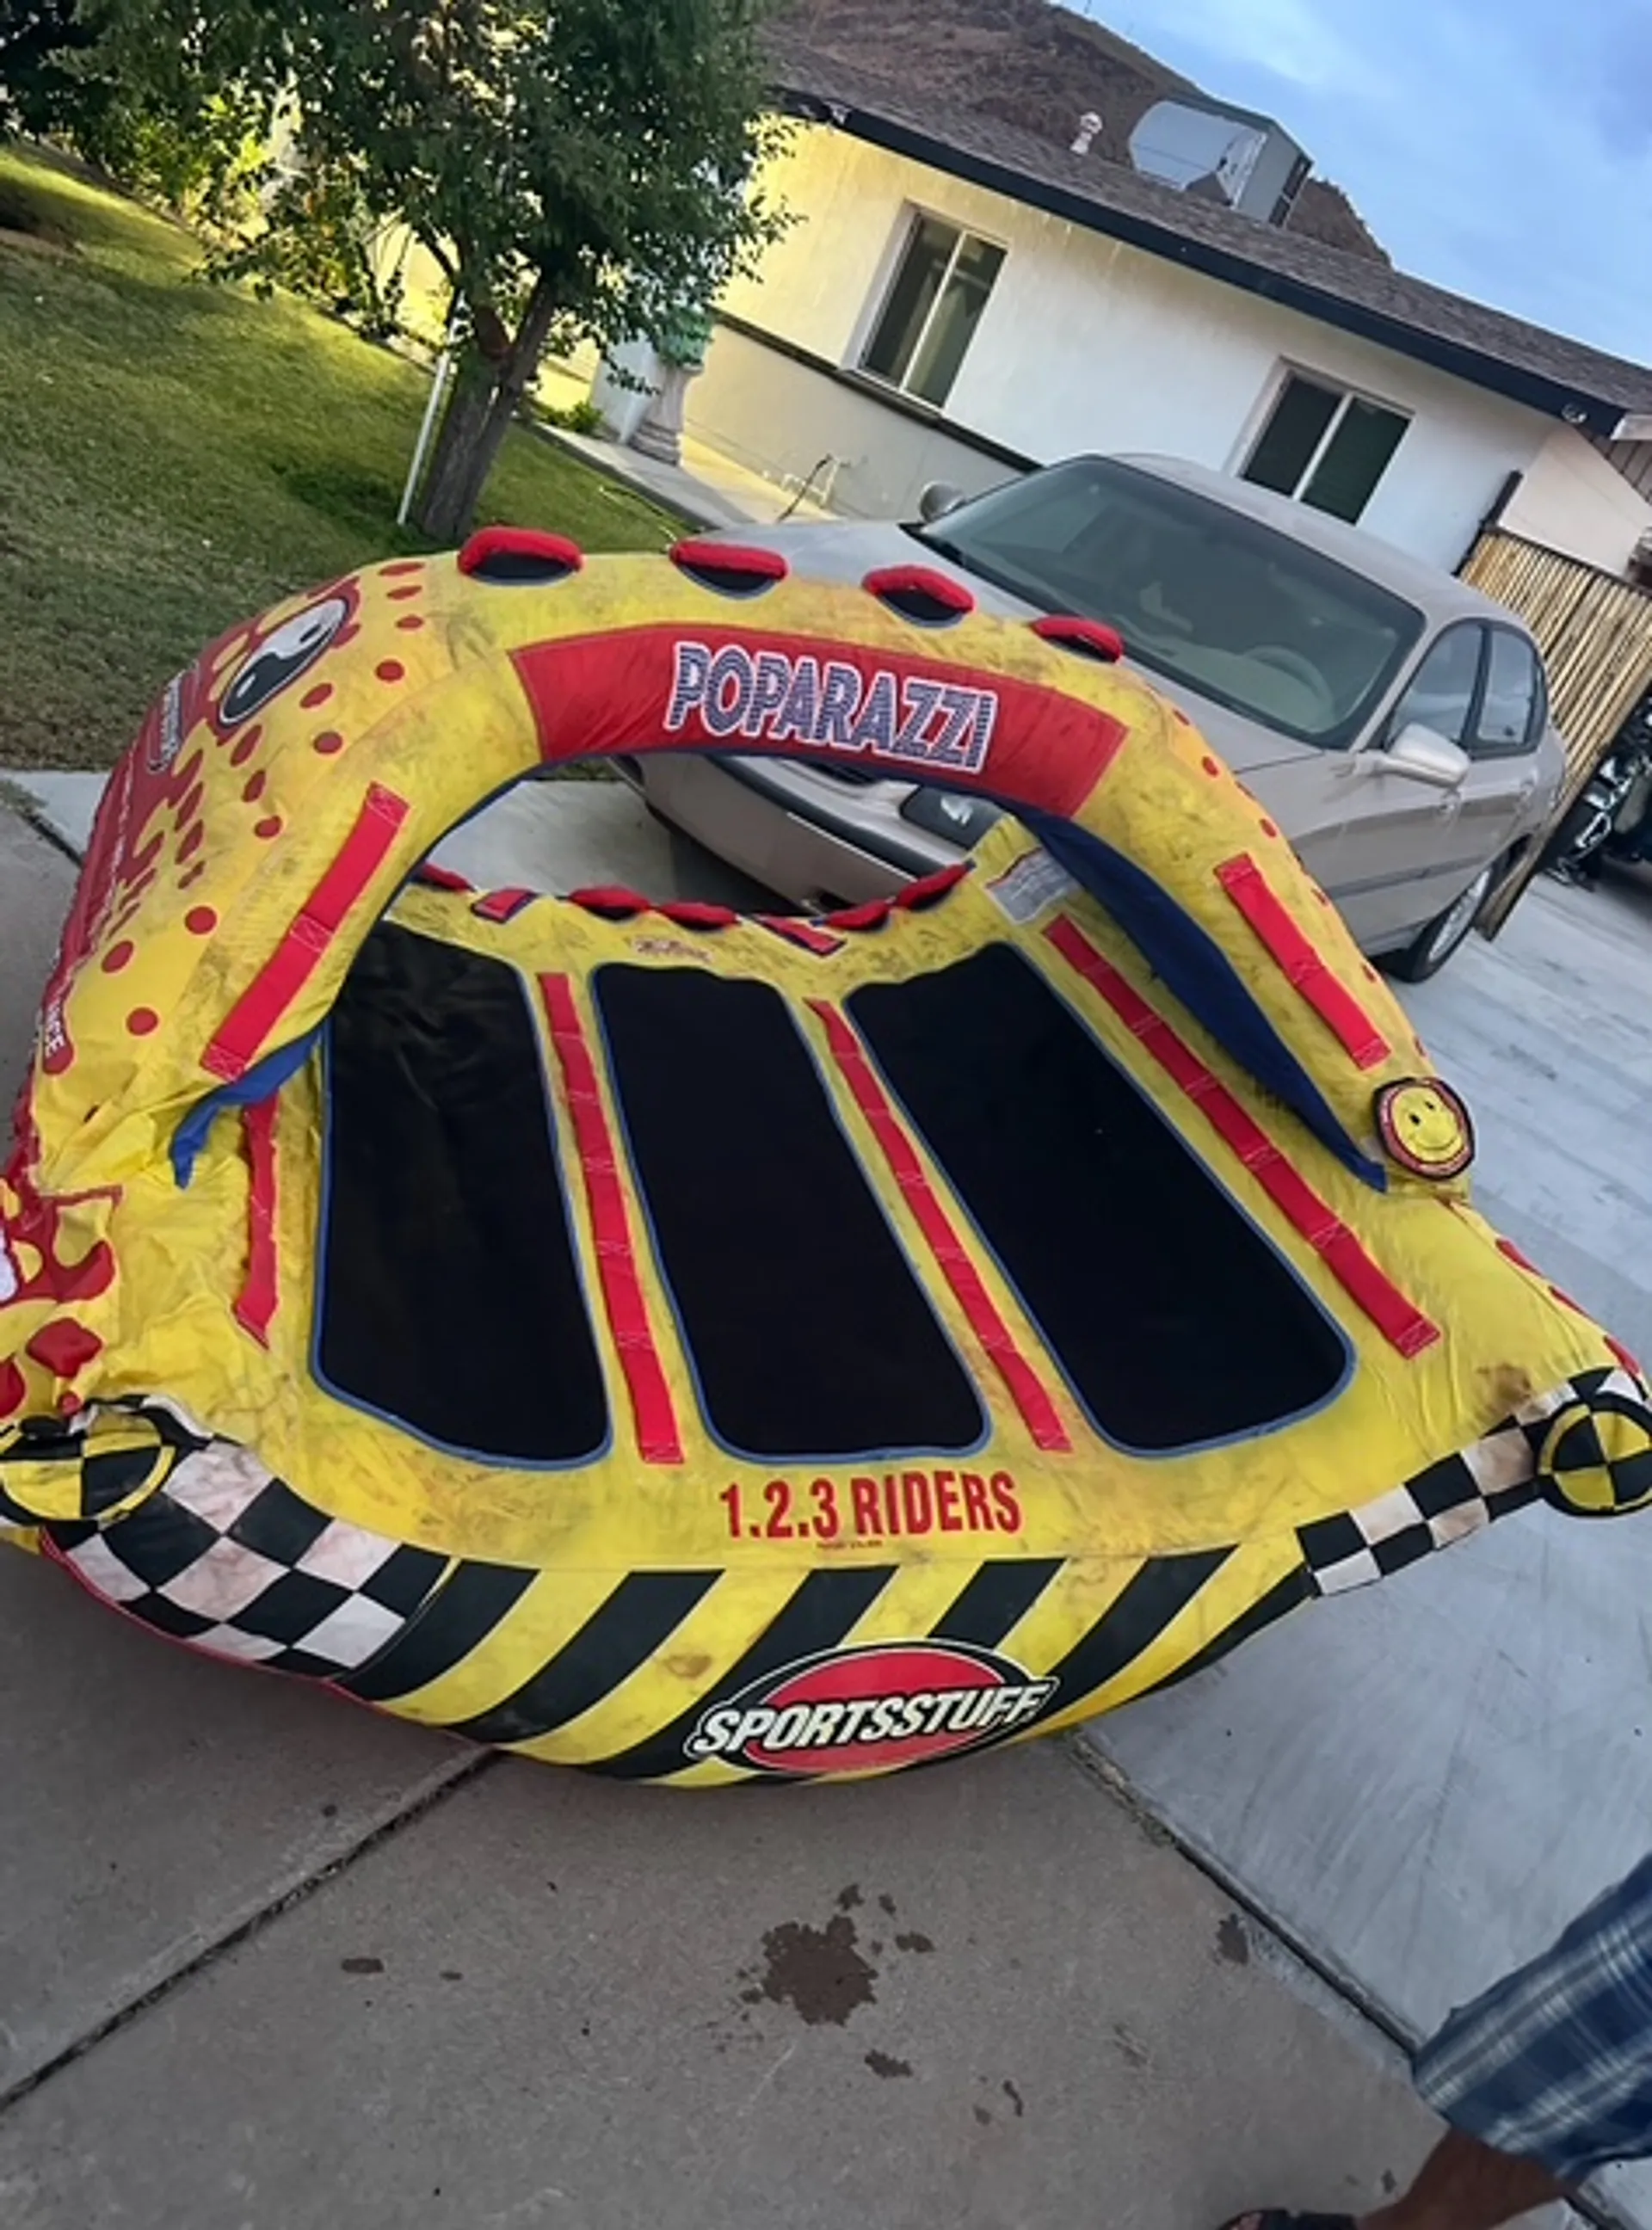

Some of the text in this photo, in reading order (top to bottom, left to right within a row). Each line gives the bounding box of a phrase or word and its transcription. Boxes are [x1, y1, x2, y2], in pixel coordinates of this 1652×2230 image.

[663, 641, 998, 773] POPARAZZI
[719, 1470, 1021, 1538] 1.2.3 RIDERS
[692, 1681, 1051, 1755] SPORTSSTUFF
